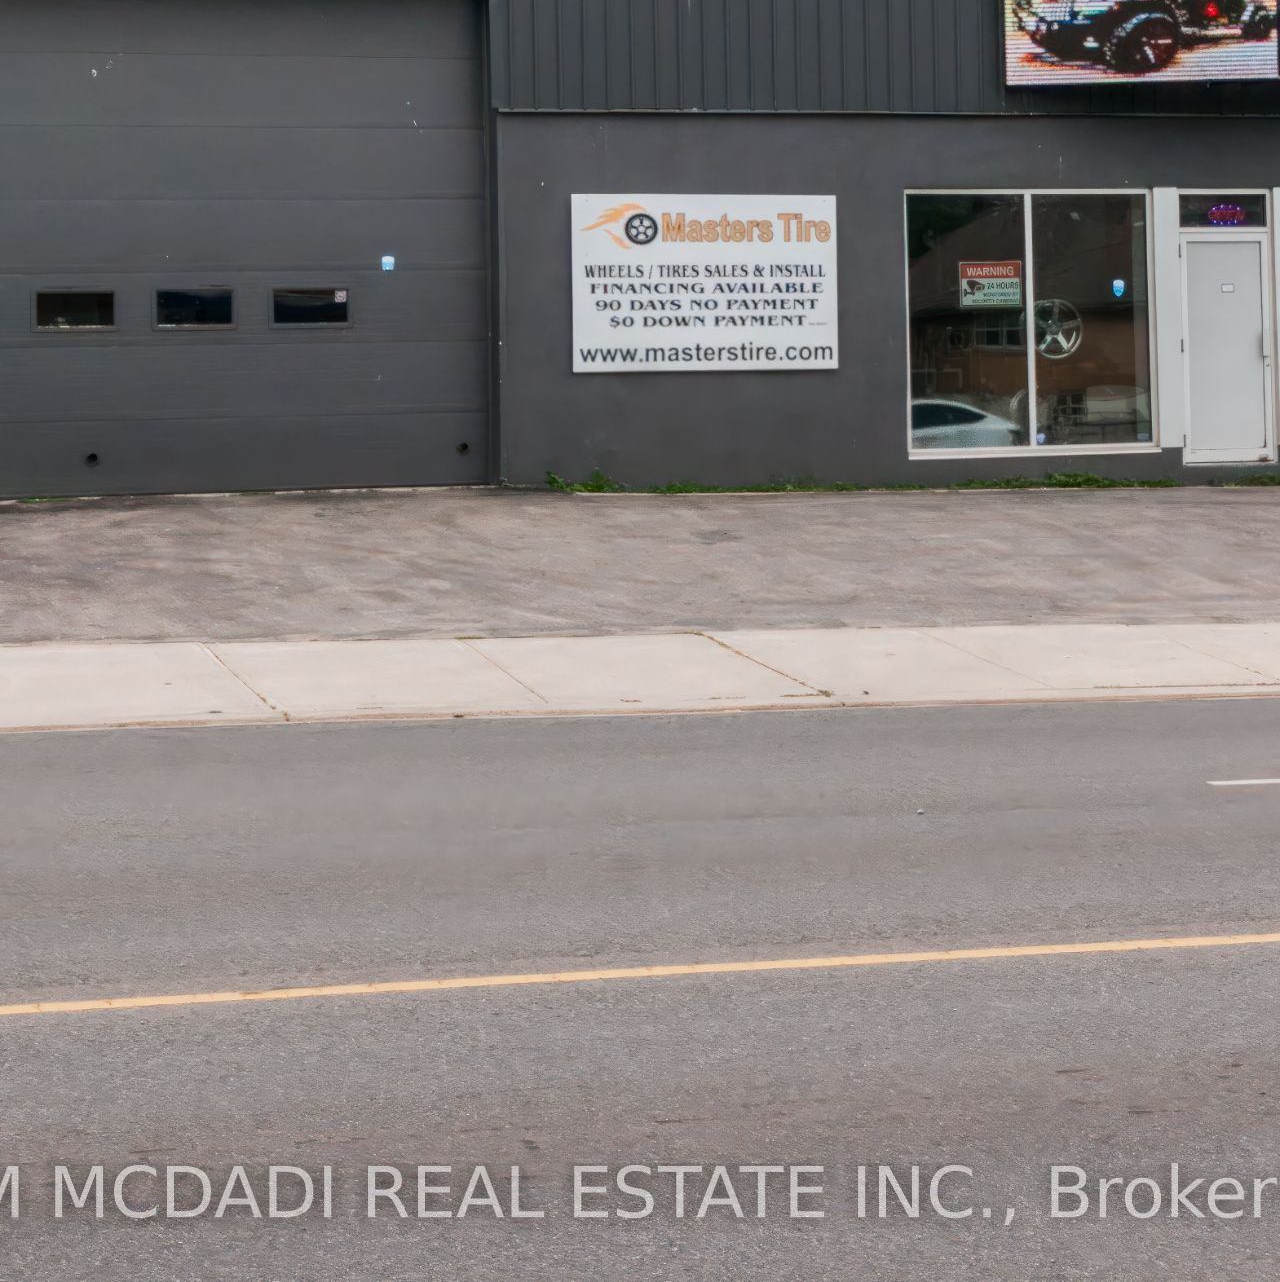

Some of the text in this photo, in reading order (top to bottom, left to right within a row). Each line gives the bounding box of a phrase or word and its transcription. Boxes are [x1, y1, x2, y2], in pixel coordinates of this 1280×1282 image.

[661, 212, 832, 243] Masters Tire
[584, 264, 645, 278] WHEELS
[658, 264, 700, 278] TIRES
[704, 264, 749, 278] SALES
[753, 263, 765, 278] &
[770, 263, 826, 278] INSTALL
[967, 266, 1014, 276] WARNING
[589, 282, 824, 295] FINANCING AVAILABLE
[595, 298, 819, 311] 90 DAYS NO PAYMENT
[609, 315, 807, 329] $0 DOWN PAYMENT
[579, 341, 834, 363] www.masterstire.com
